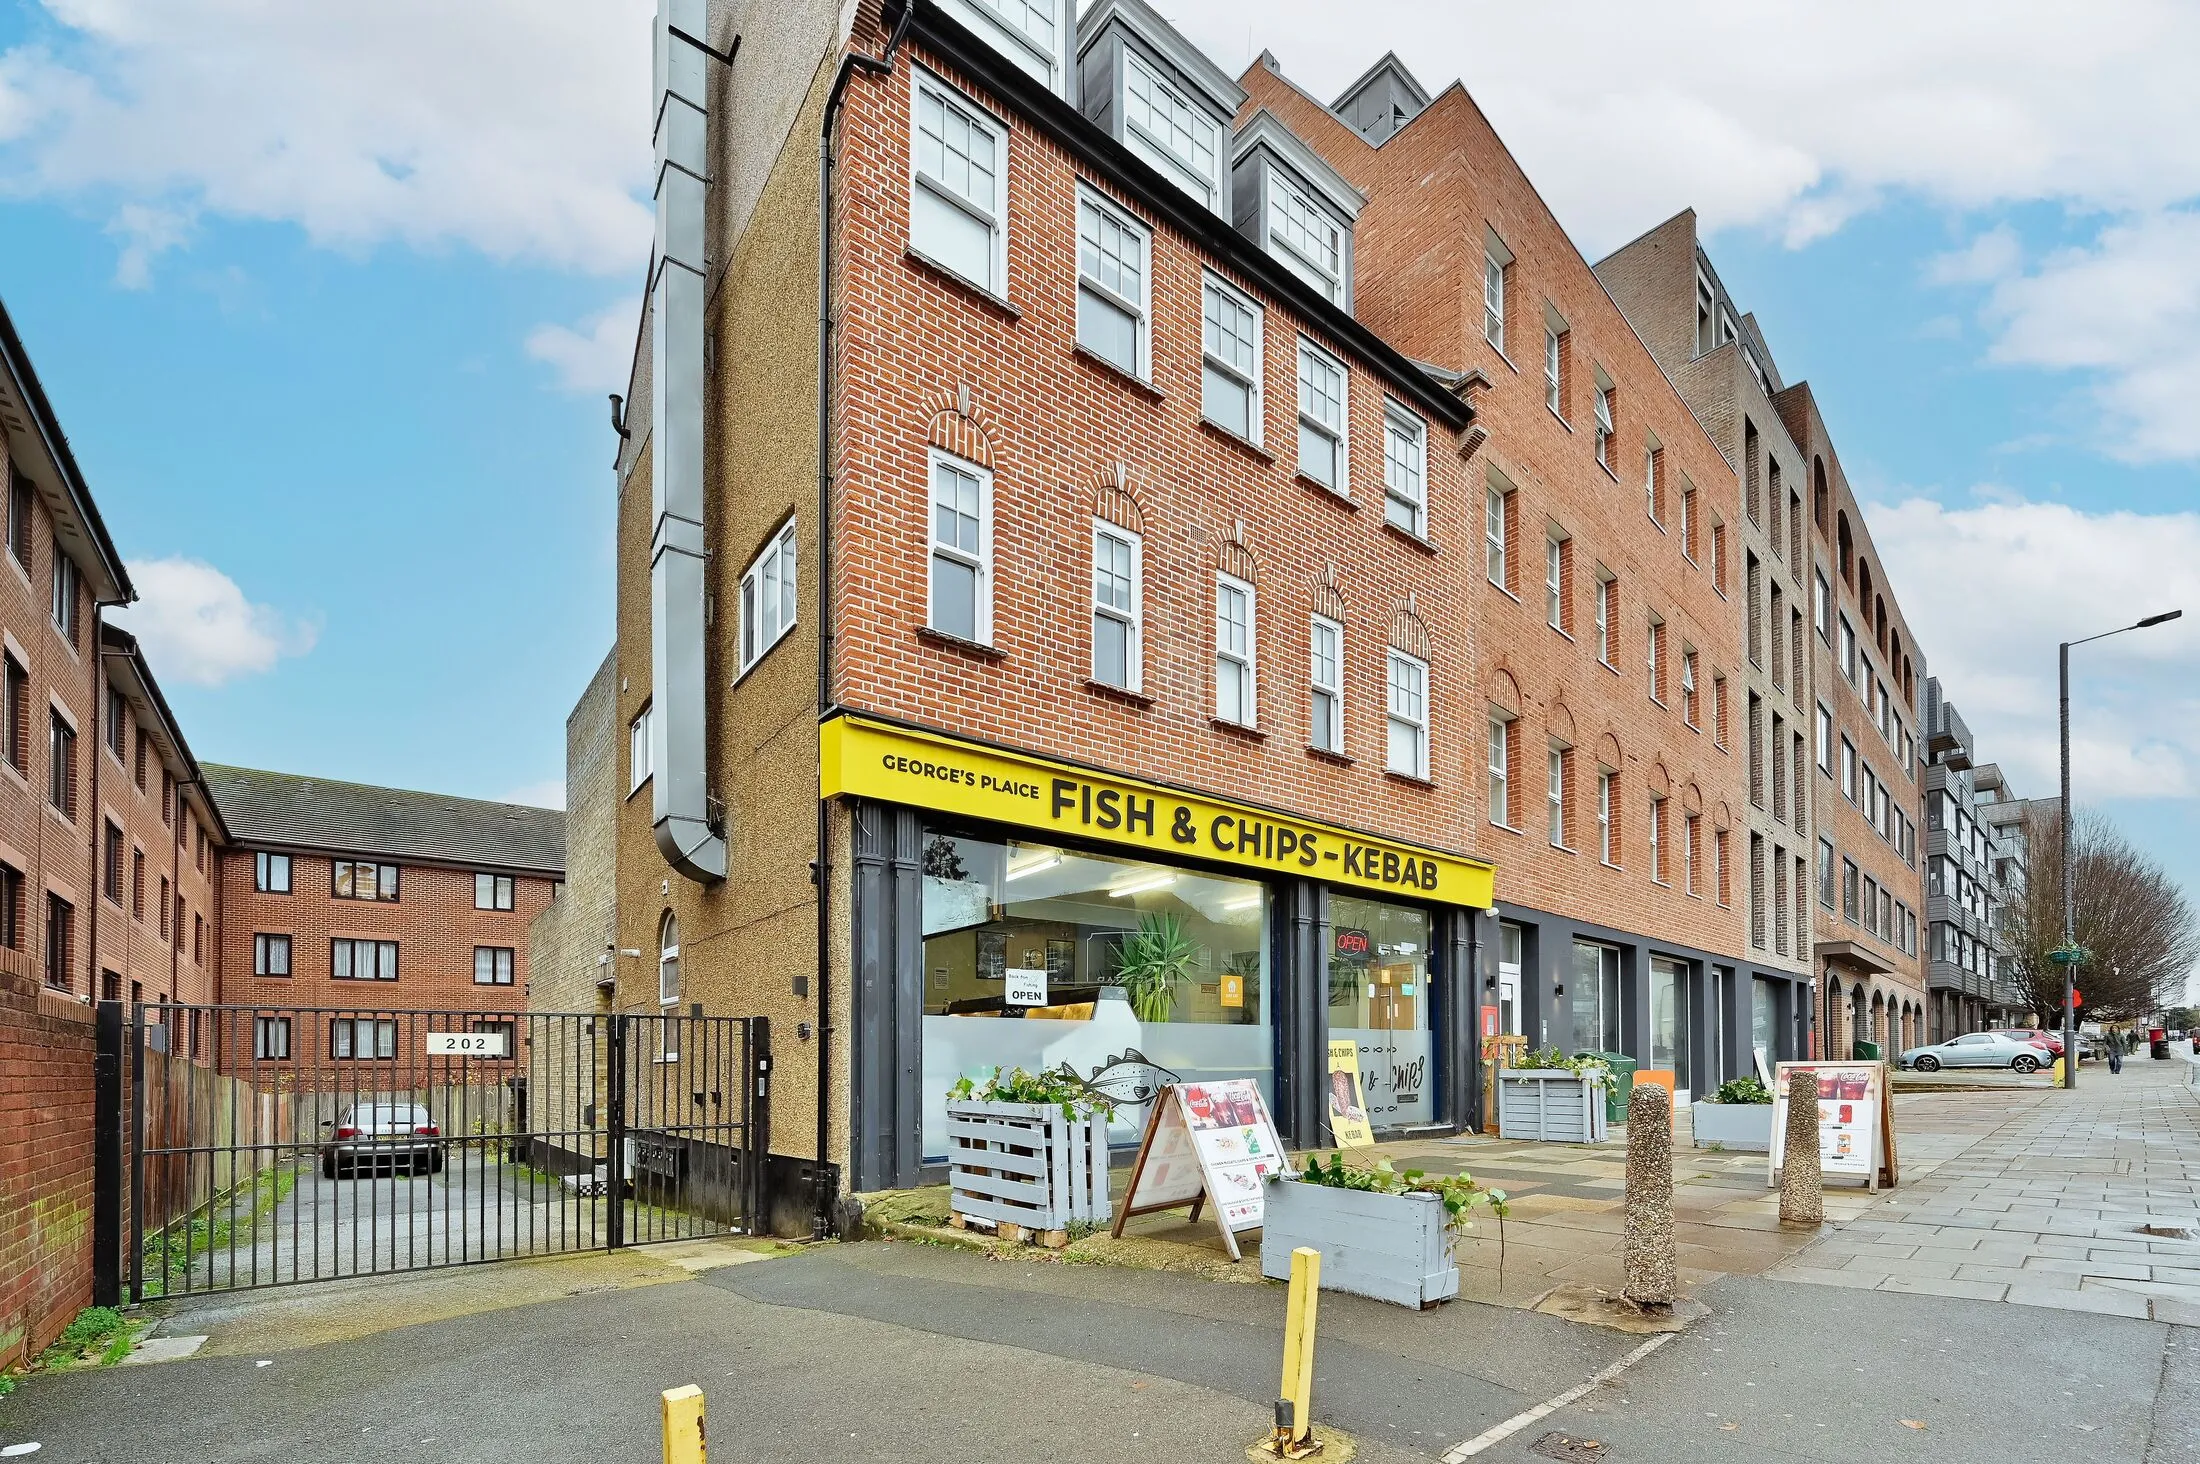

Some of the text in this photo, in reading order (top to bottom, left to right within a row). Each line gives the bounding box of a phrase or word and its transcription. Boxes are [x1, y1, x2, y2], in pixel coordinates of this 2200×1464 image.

[882, 754, 976, 787] GEORGE'S
[981, 775, 1040, 800] PLAICE
[1052, 778, 1154, 836] FISH
[1171, 806, 1197, 844] &
[1337, 934, 1368, 952] OPEN
[1012, 990, 1042, 1001] OPEN
[446, 1038, 485, 1050] 202
[1368, 1070, 1379, 1091] &
